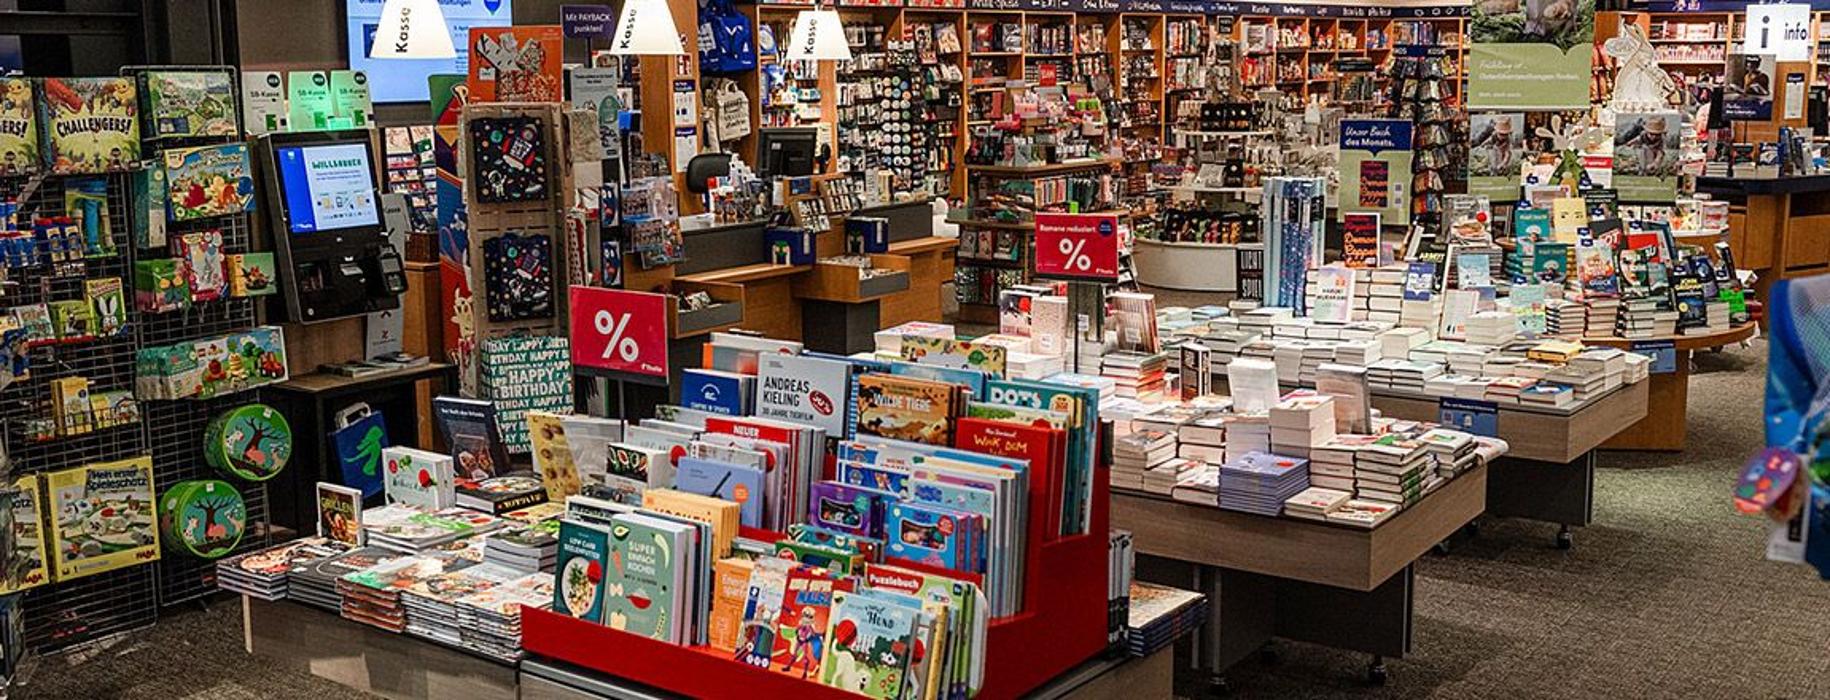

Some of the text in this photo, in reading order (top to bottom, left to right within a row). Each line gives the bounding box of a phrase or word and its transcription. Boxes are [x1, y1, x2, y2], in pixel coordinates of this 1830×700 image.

[579, 13, 611, 21] PAYBACK
[396, 8, 412, 53] Kasse
[620, 9, 637, 49] Kasse
[803, 19, 817, 54] Kasse
[1784, 22, 1808, 40] info
[56, 117, 133, 138] CHALLENGERS!
[1345, 125, 1391, 136] Unser Buch
[1345, 138, 1395, 147] des Monats.
[1066, 225, 1096, 233] reduziert
[508, 368, 554, 384] HAPPY
[501, 381, 564, 399] BIRTHDAY
[763, 375, 810, 394] ANDREAS
[763, 390, 800, 407] KIELING
[872, 392, 933, 413] WILDE TIERE
[989, 386, 1042, 409] DOTS
[89, 470, 112, 480] Mein
[86, 477, 147, 491] Spieleschatz
[569, 537, 581, 547] LOW
[627, 540, 656, 556] SUPER
[627, 551, 656, 566] EINFACH
[626, 561, 656, 577] KOCHEN
[869, 573, 920, 590] Puzzlebuch
